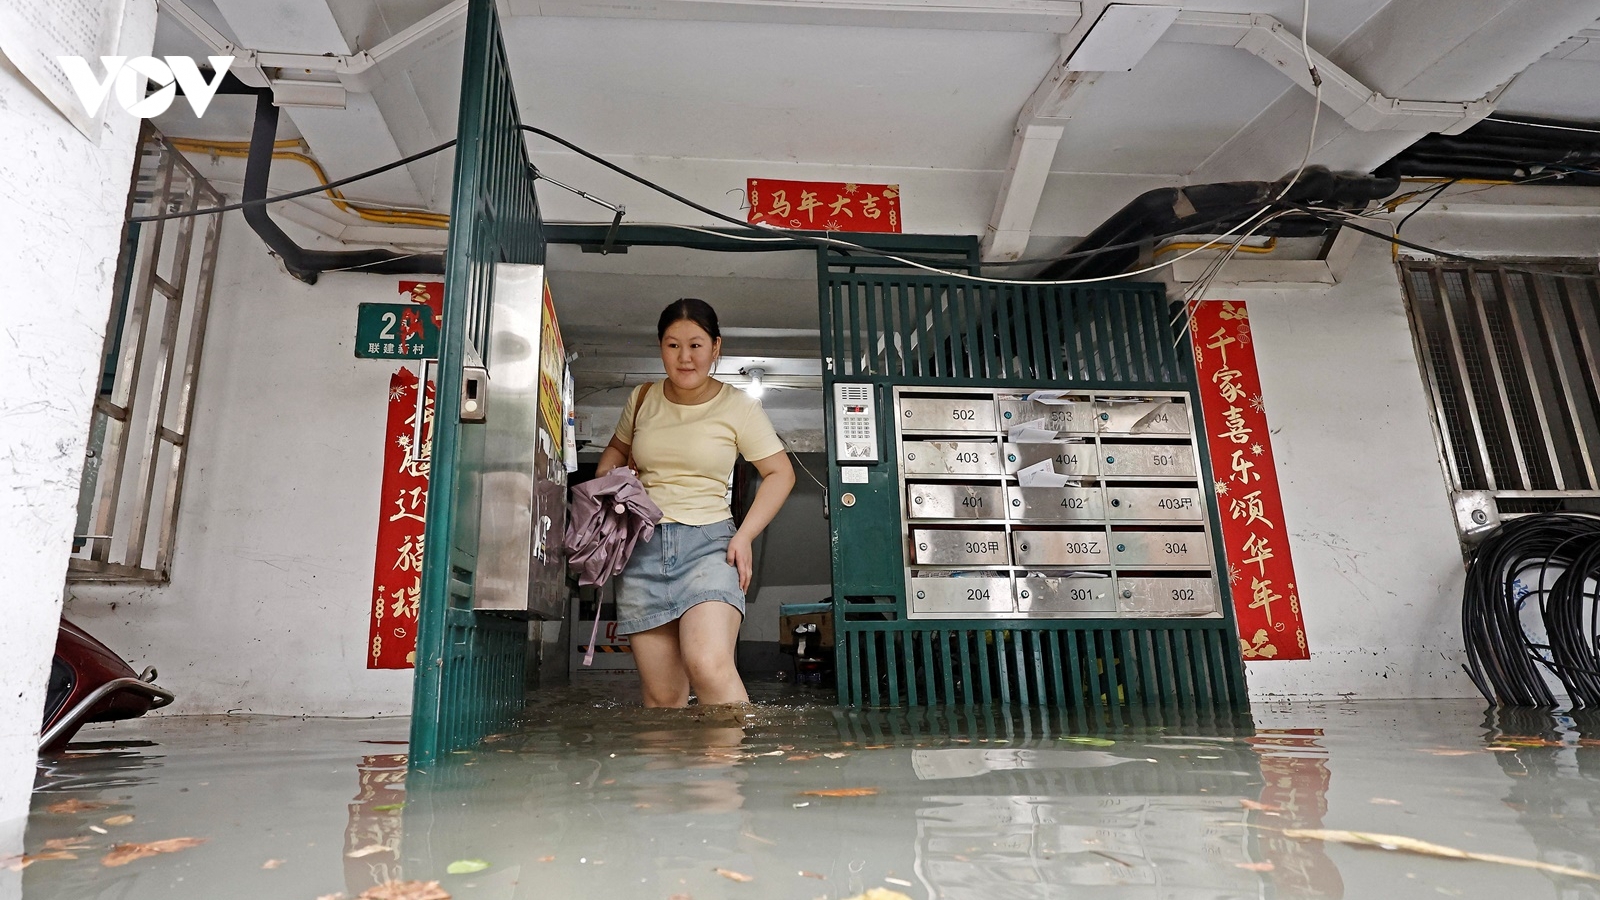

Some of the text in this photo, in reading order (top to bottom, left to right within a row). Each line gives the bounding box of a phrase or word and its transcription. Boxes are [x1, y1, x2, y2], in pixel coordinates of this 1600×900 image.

[767, 189, 882, 223] 马年大吉
[379, 312, 417, 340] 2
[952, 410, 975, 421] 502
[1051, 411, 1074, 422] 503
[956, 452, 979, 463] 403
[1055, 454, 1078, 465] 404
[1153, 455, 1175, 466] 501
[1206, 326, 1283, 627] 千家喜乐颂华年
[962, 496, 983, 508] 401
[1060, 498, 1084, 509] 402
[1158, 497, 1192, 510] 403甲
[965, 541, 999, 554] 303甲
[1066, 542, 1101, 554] 303乙
[1165, 543, 1188, 554] 304
[966, 589, 991, 601] 204
[1070, 589, 1093, 601] 301
[1172, 589, 1195, 601] 302
